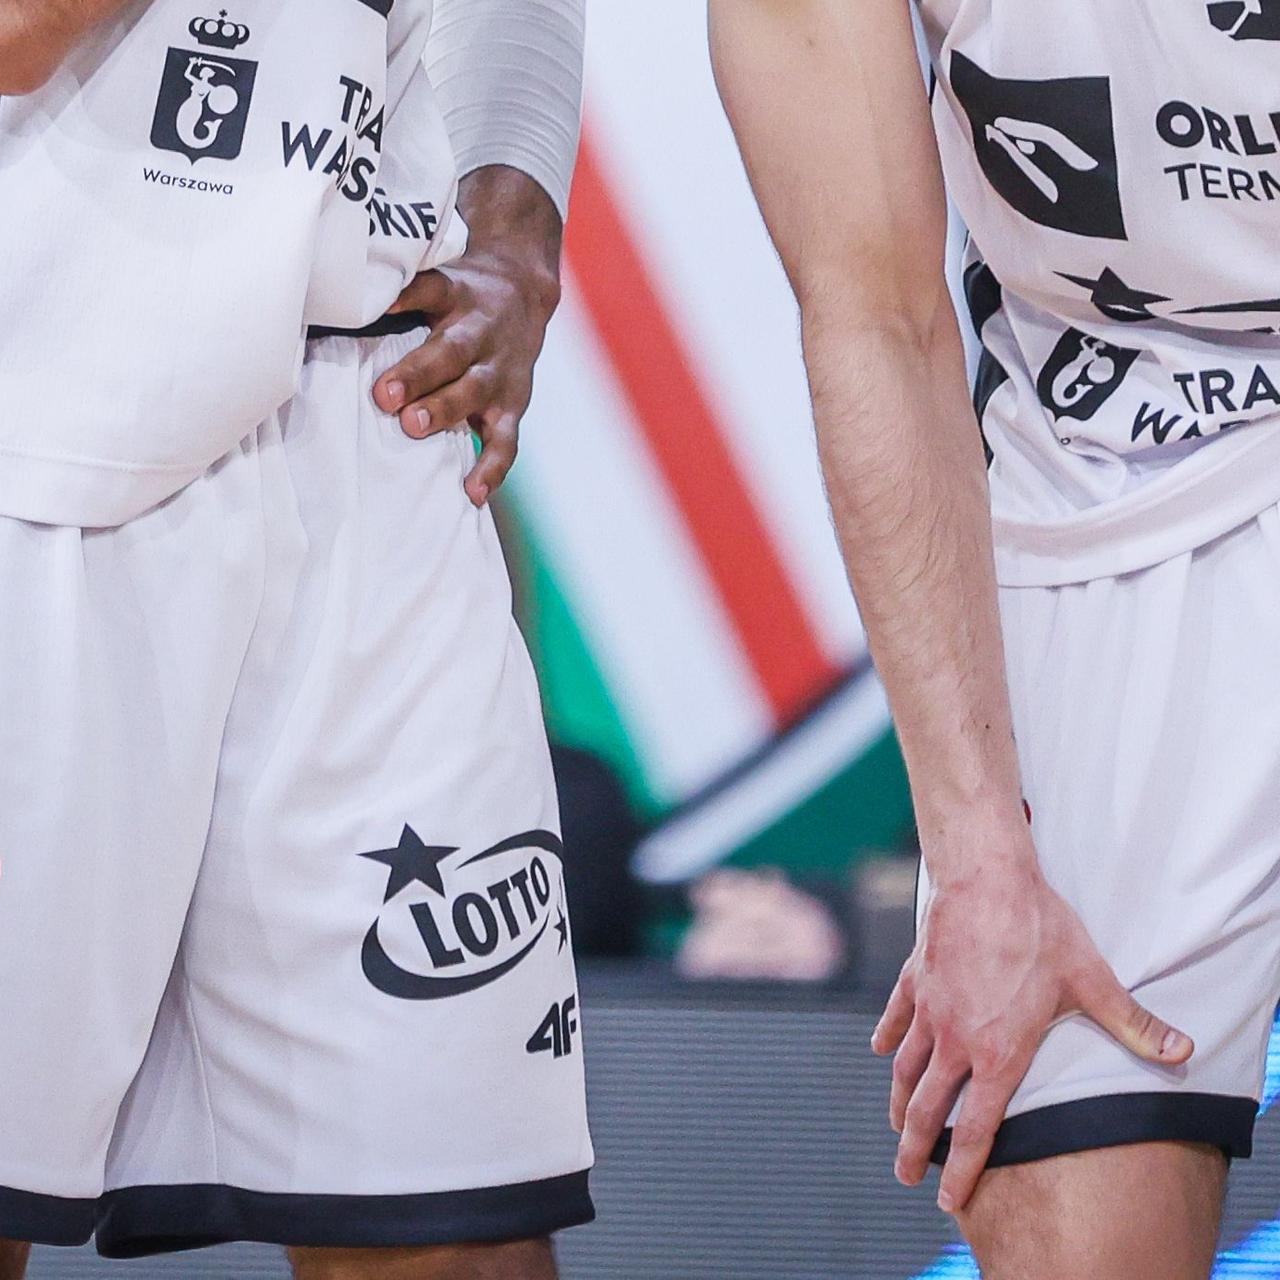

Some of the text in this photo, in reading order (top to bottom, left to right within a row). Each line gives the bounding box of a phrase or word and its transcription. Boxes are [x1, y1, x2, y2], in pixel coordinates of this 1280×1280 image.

[143, 167, 234, 195] Warszawa
[409, 856, 550, 969] LOTTO
[525, 993, 577, 1059] 4F
